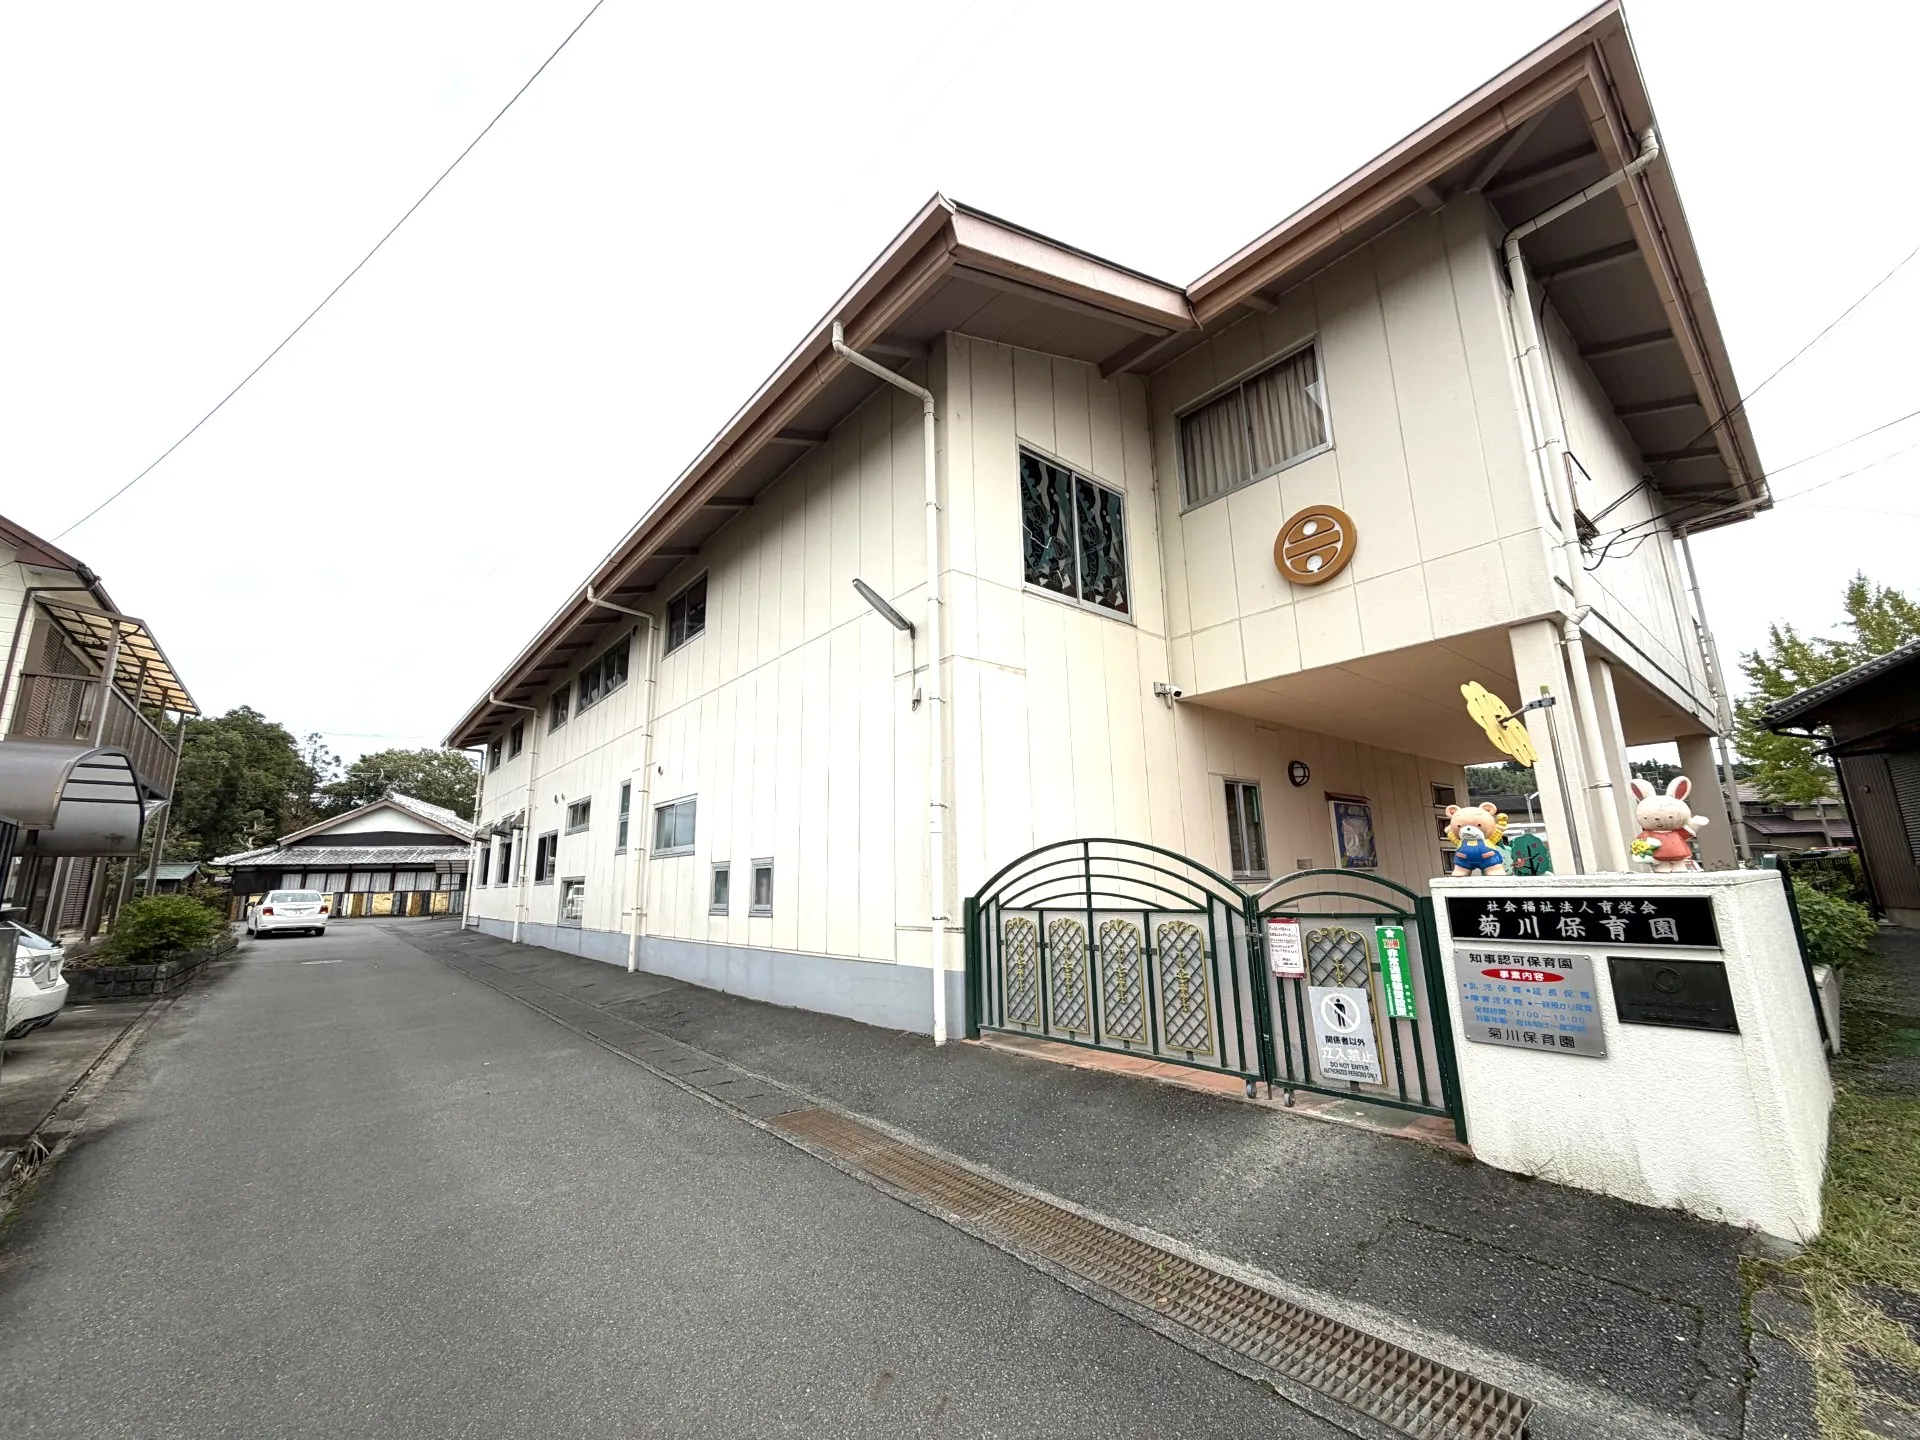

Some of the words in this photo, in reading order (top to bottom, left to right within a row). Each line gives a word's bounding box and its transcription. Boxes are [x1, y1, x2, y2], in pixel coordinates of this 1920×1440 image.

[1486, 900, 1658, 915] 社会福祉法人育栄会
[1478, 915, 1679, 942] 菊川保育園
[1469, 953, 1573, 969] 知事認可保育園
[1499, 970, 1544, 982] 事業内容
[1325, 1035, 1365, 1047] 関係者以外
[1487, 1027, 1575, 1048] 菊川保育園
[1321, 1046, 1374, 1063] 立入禁止
[1351, 1063, 1369, 1071] ENTER
